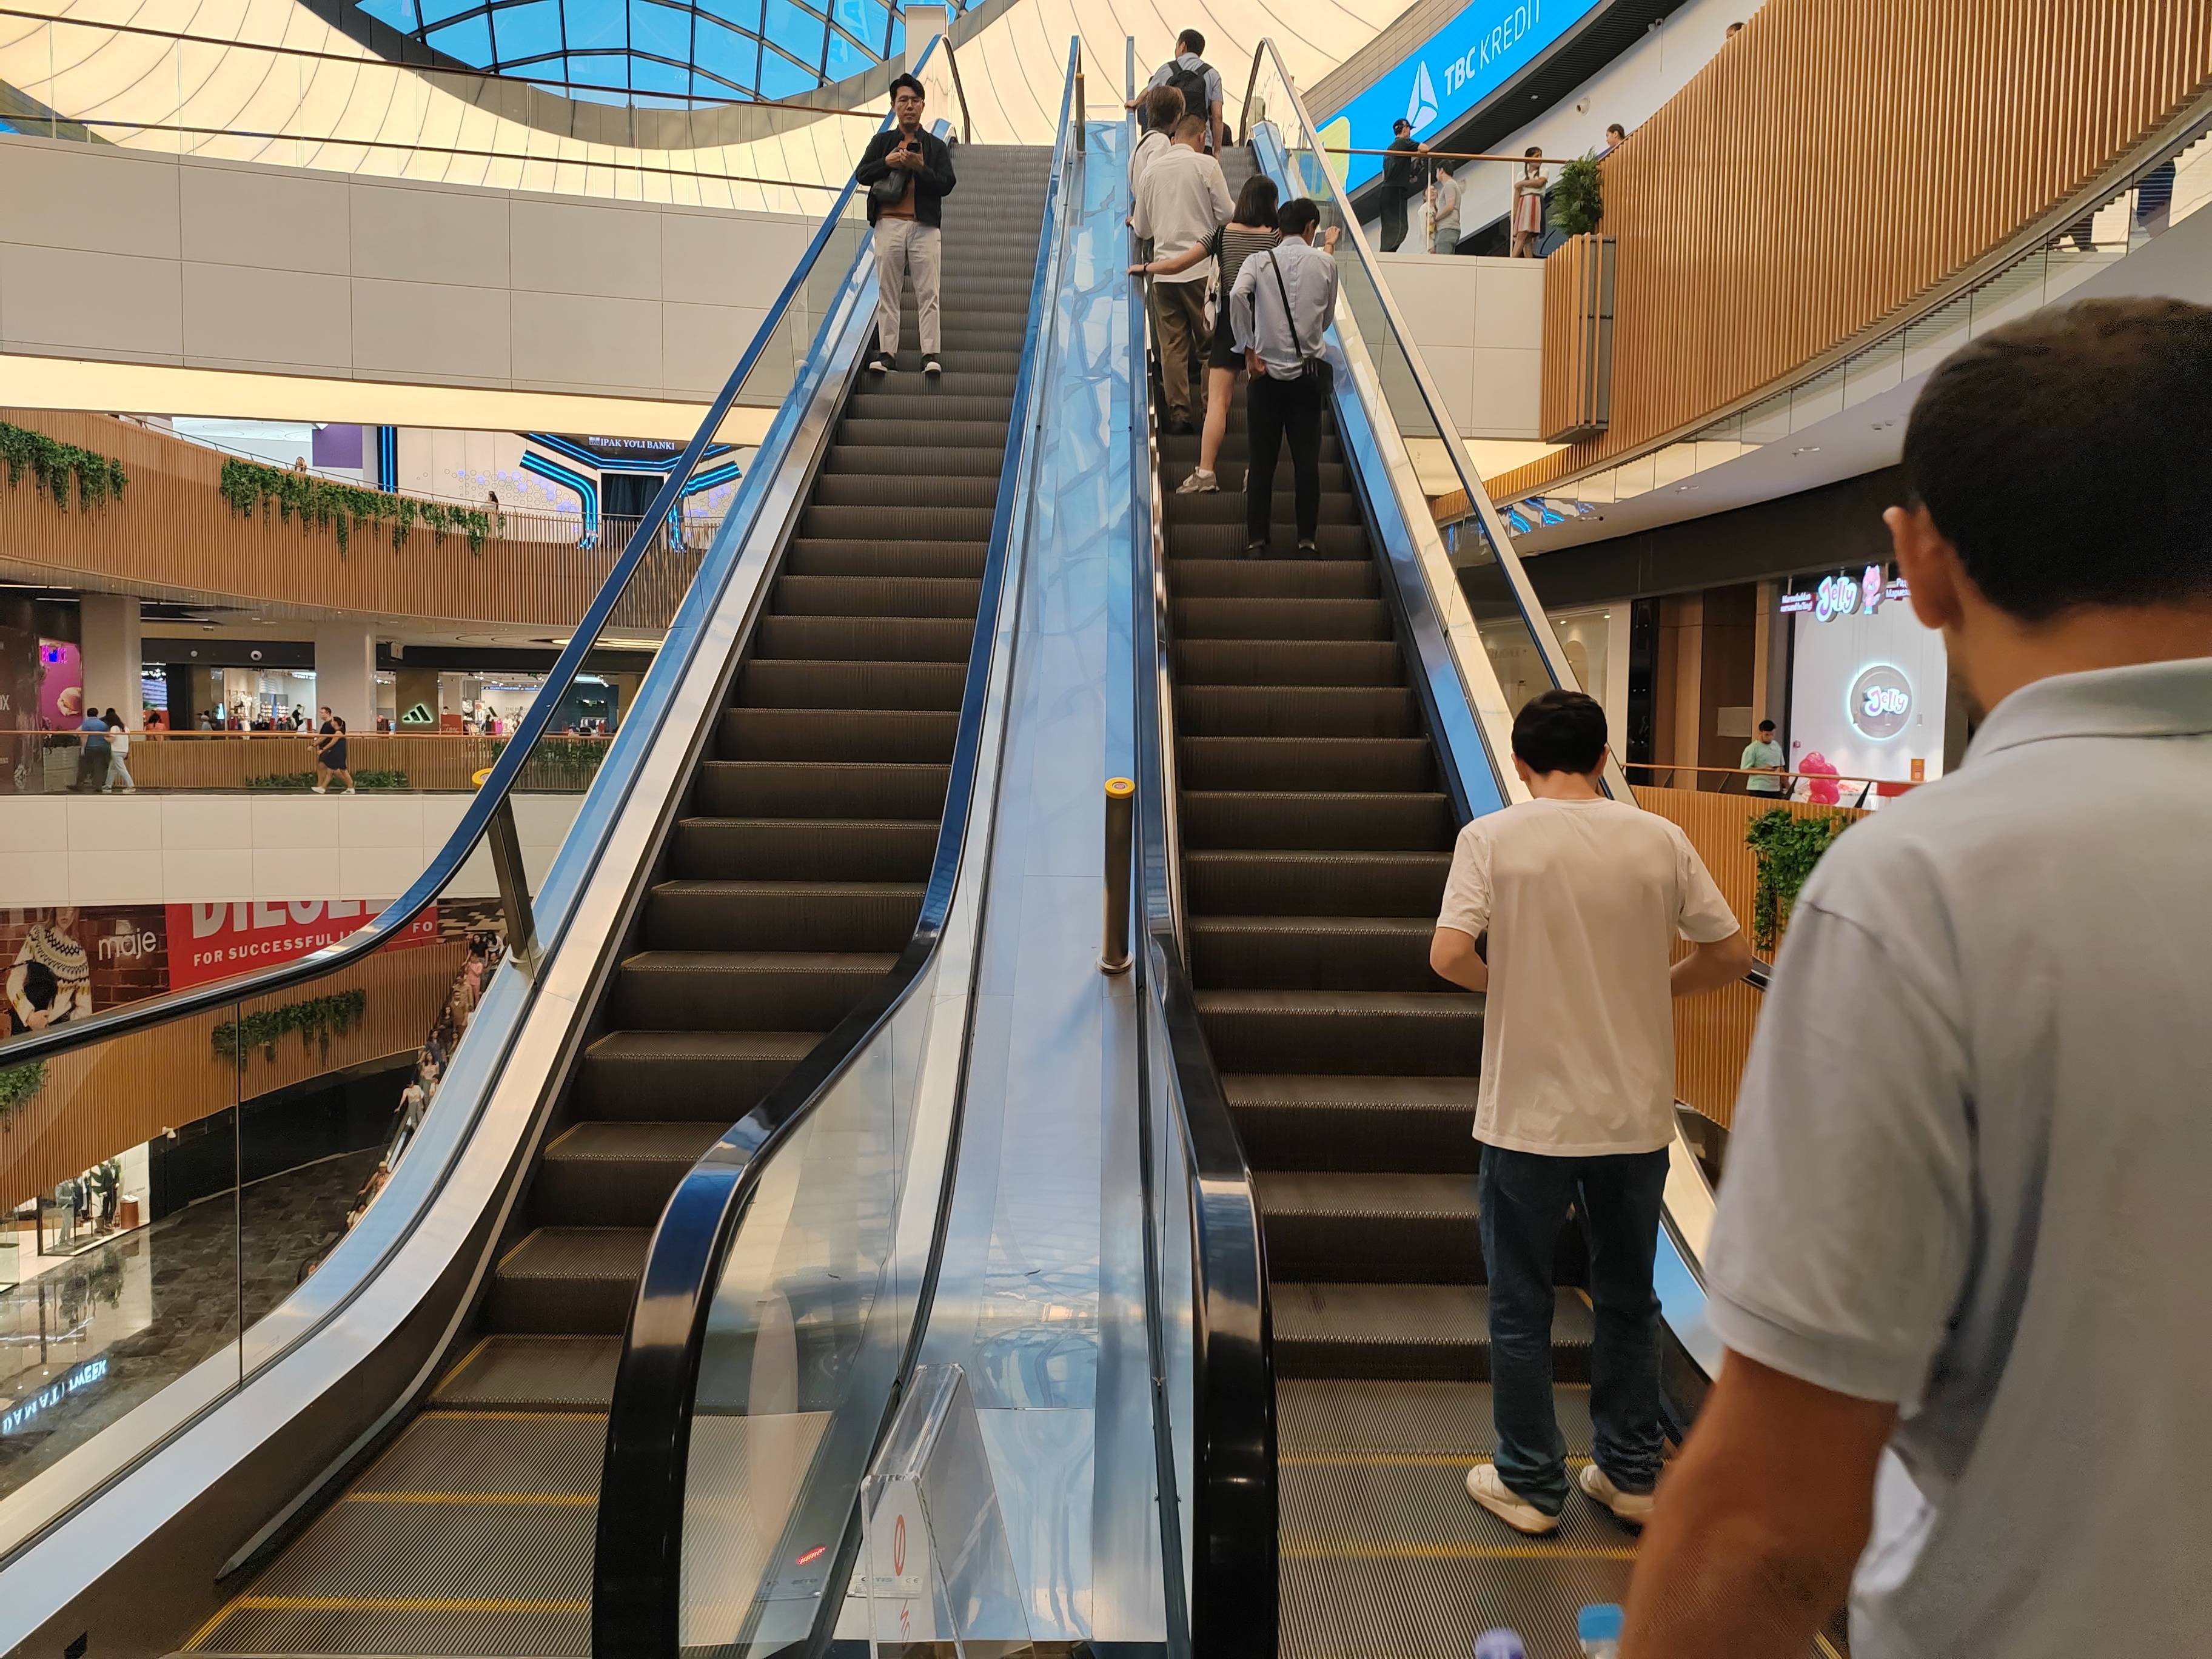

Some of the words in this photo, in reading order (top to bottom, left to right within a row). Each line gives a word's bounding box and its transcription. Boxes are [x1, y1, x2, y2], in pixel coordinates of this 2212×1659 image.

[1444, 45, 1476, 96] TBC
[601, 438, 622, 447] IPAK
[647, 441, 675, 450] BANKI
[1817, 577, 1857, 620] Jelly
[1866, 686, 1908, 716] Jelly
[98, 928, 156, 961] maje
[193, 950, 223, 967] FOR
[229, 932, 334, 960] SUCCESSFUL
